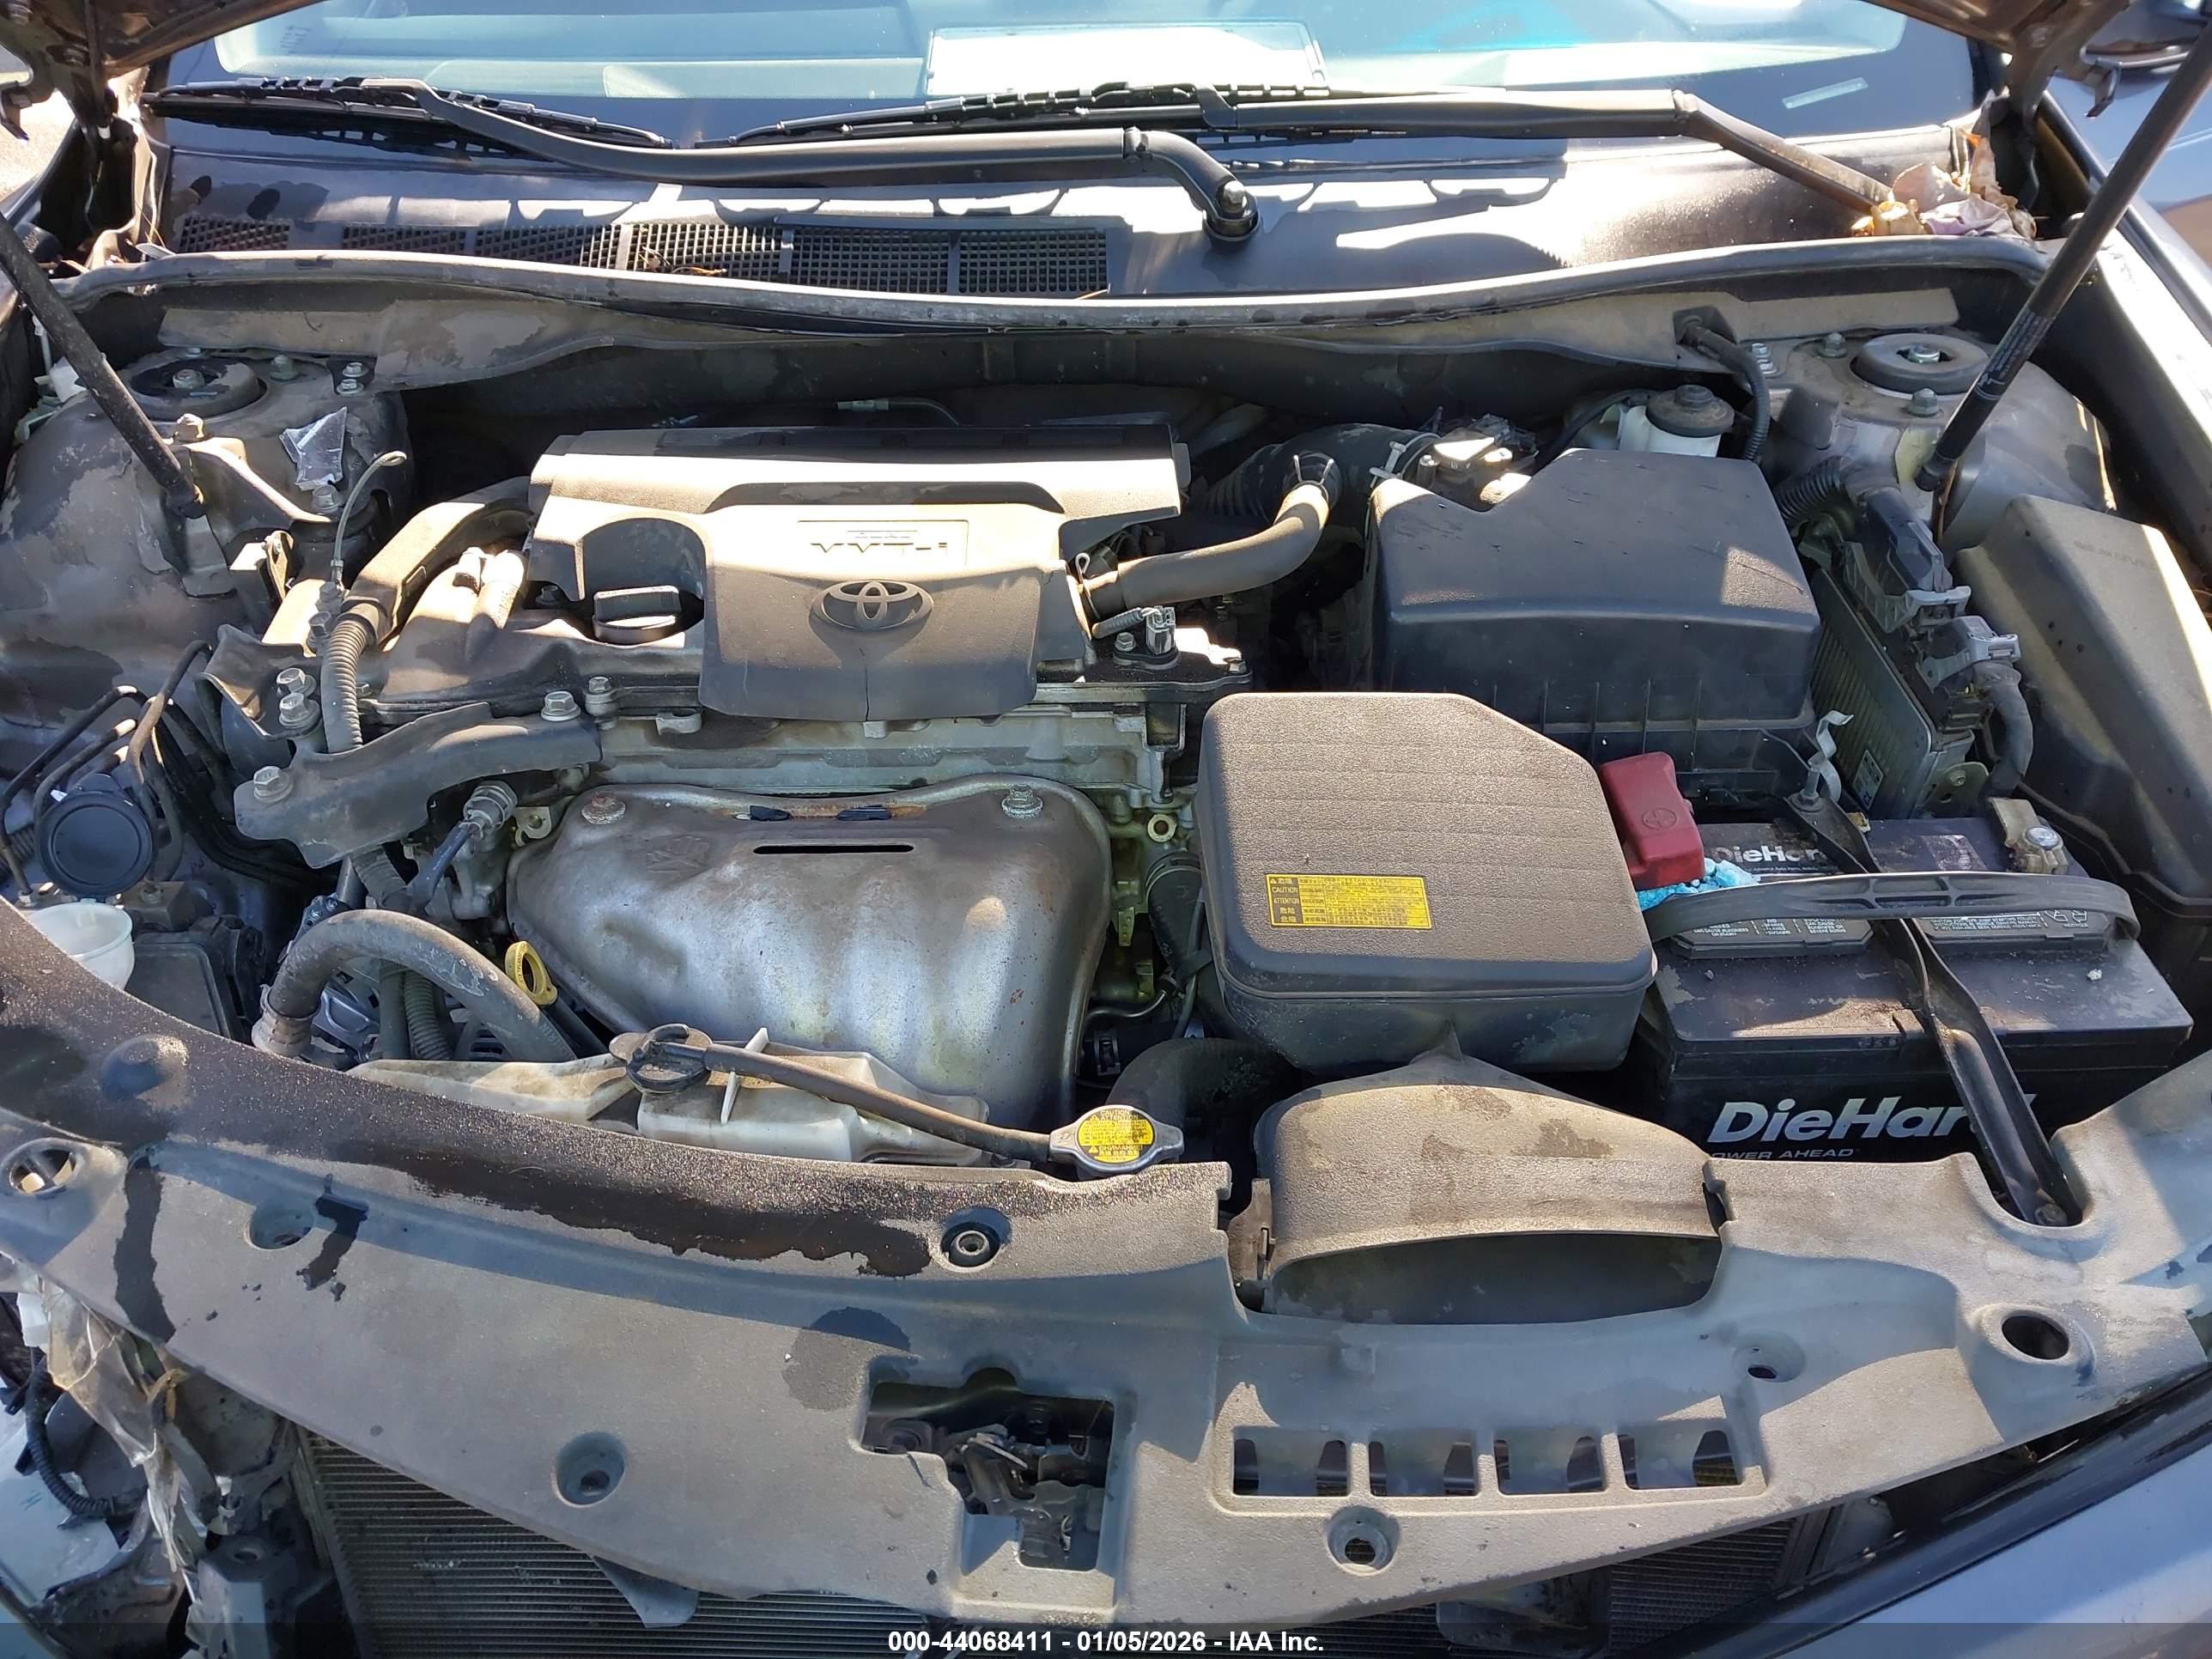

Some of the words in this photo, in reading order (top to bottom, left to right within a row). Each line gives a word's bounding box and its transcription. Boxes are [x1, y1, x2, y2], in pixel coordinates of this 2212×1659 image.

[1711, 845, 1828, 862] DieHar
[1707, 1094, 2037, 1143] DieHar
[1711, 1152, 1773, 1160] OWER
[1778, 1149, 1854, 1159] AHEAD
